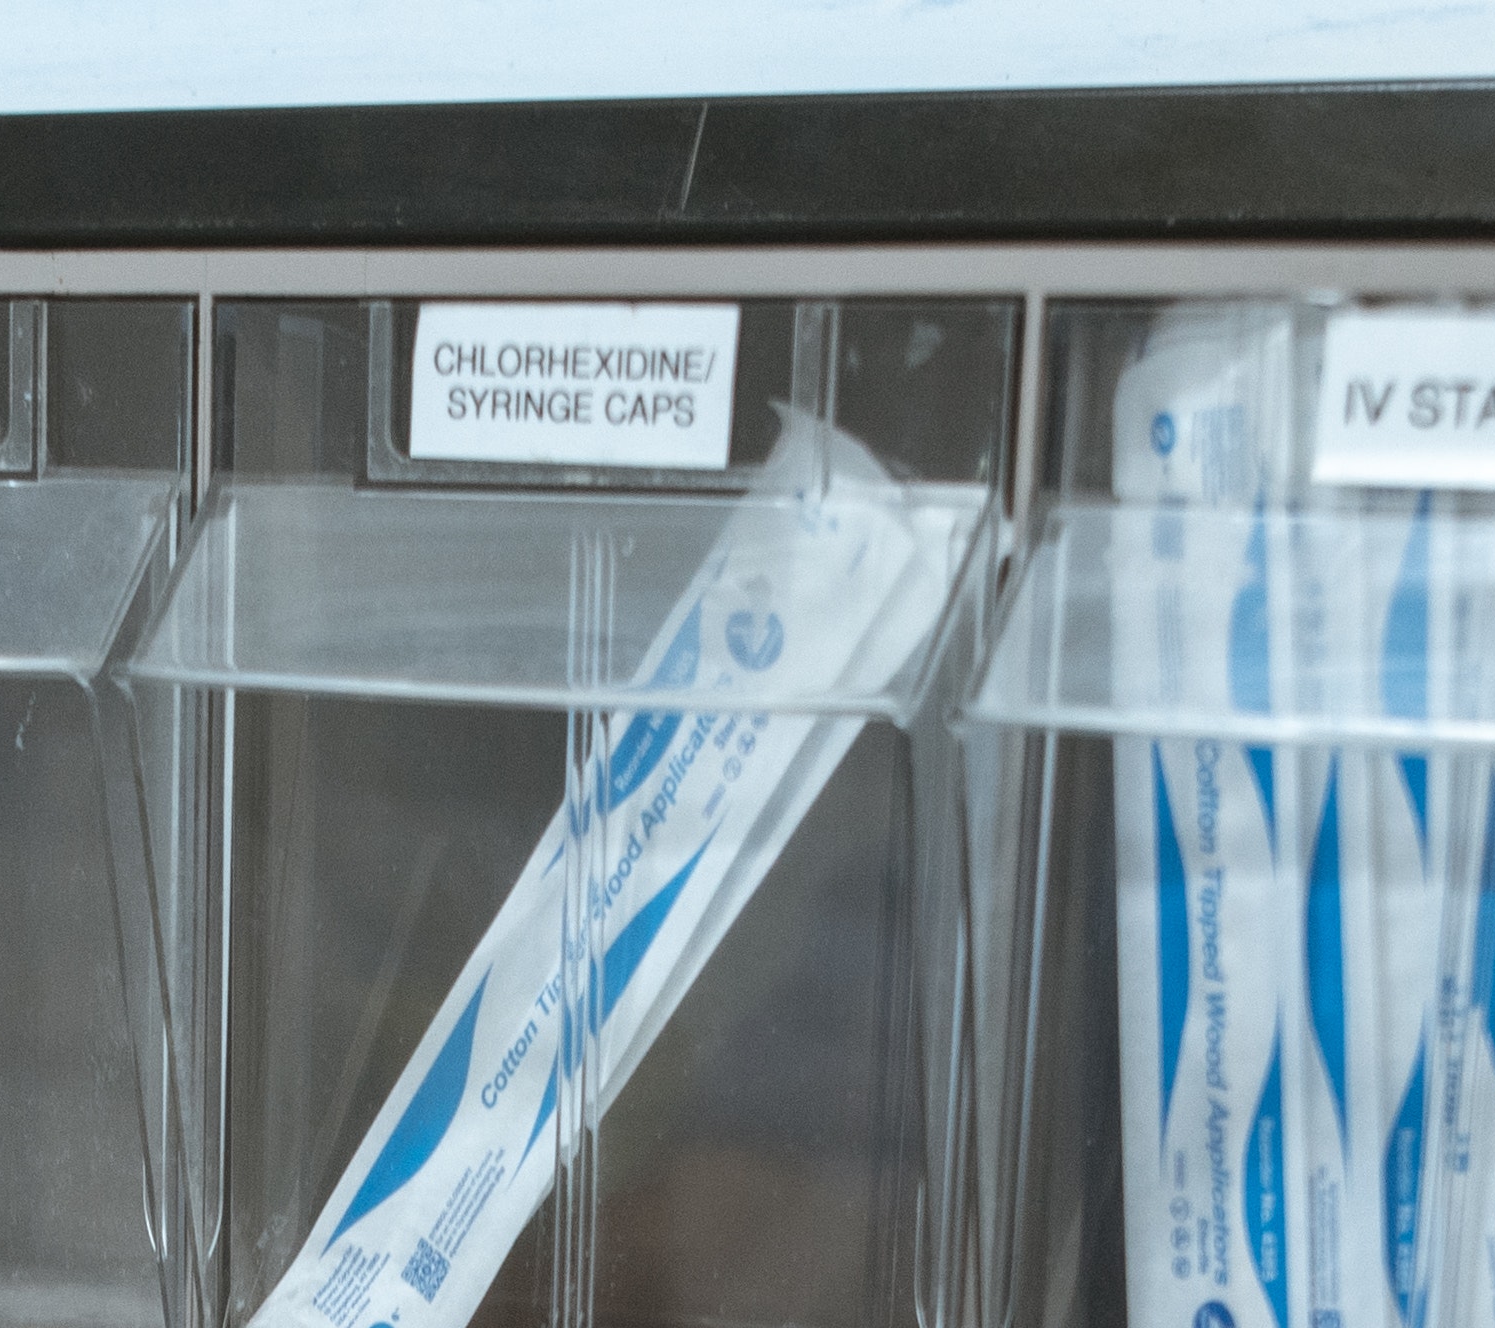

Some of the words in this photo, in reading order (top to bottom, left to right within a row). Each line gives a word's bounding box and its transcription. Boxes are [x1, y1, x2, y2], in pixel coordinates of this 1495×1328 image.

[433, 342, 716, 383] CHLORHEXIDINE/
[448, 389, 592, 424] SYRINGE
[605, 393, 695, 427] CAPS
[1343, 382, 1396, 425] IV
[1194, 739, 1224, 853] Cotton
[1195, 867, 1228, 981] Tipped
[480, 1018, 539, 1110] Cotton
[1203, 992, 1230, 1092] Wood
[1205, 1097, 1232, 1286] Applicators
